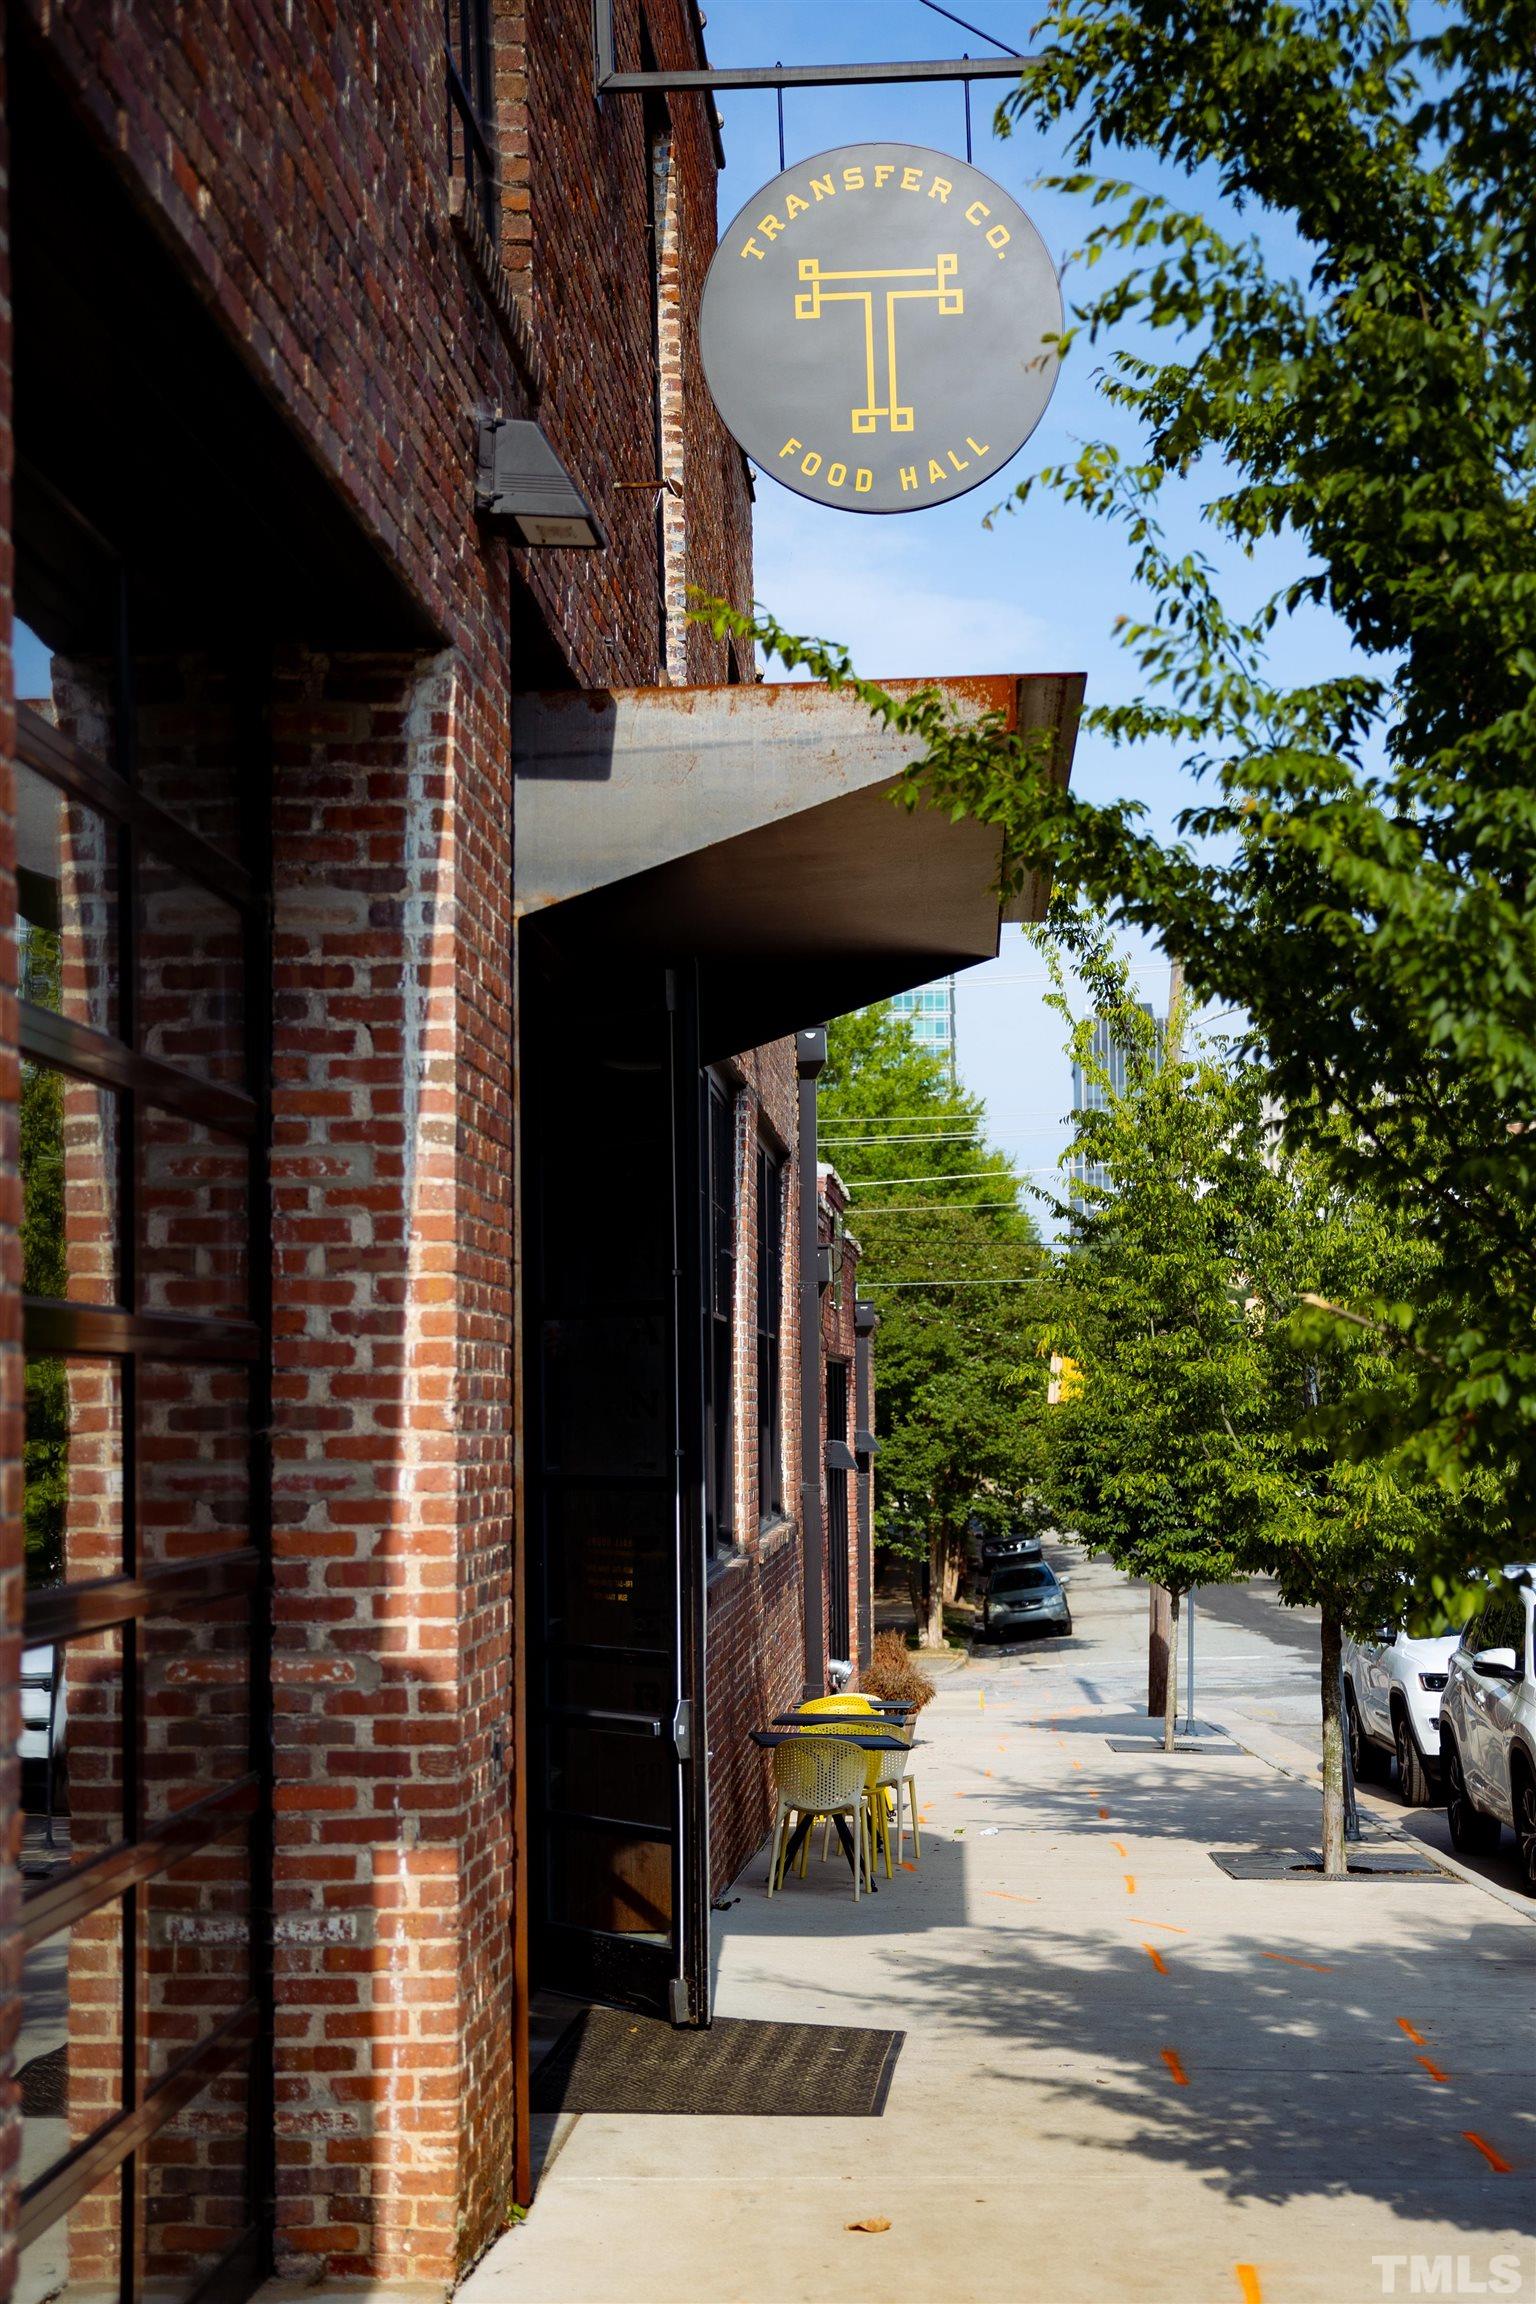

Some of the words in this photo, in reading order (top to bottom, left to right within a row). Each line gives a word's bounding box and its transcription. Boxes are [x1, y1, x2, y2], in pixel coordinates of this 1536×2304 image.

[740, 165, 953, 260] TRANSFER
[965, 201, 1011, 260] CO.
[778, 437, 873, 493] FOOD
[899, 436, 990, 492] HALL
